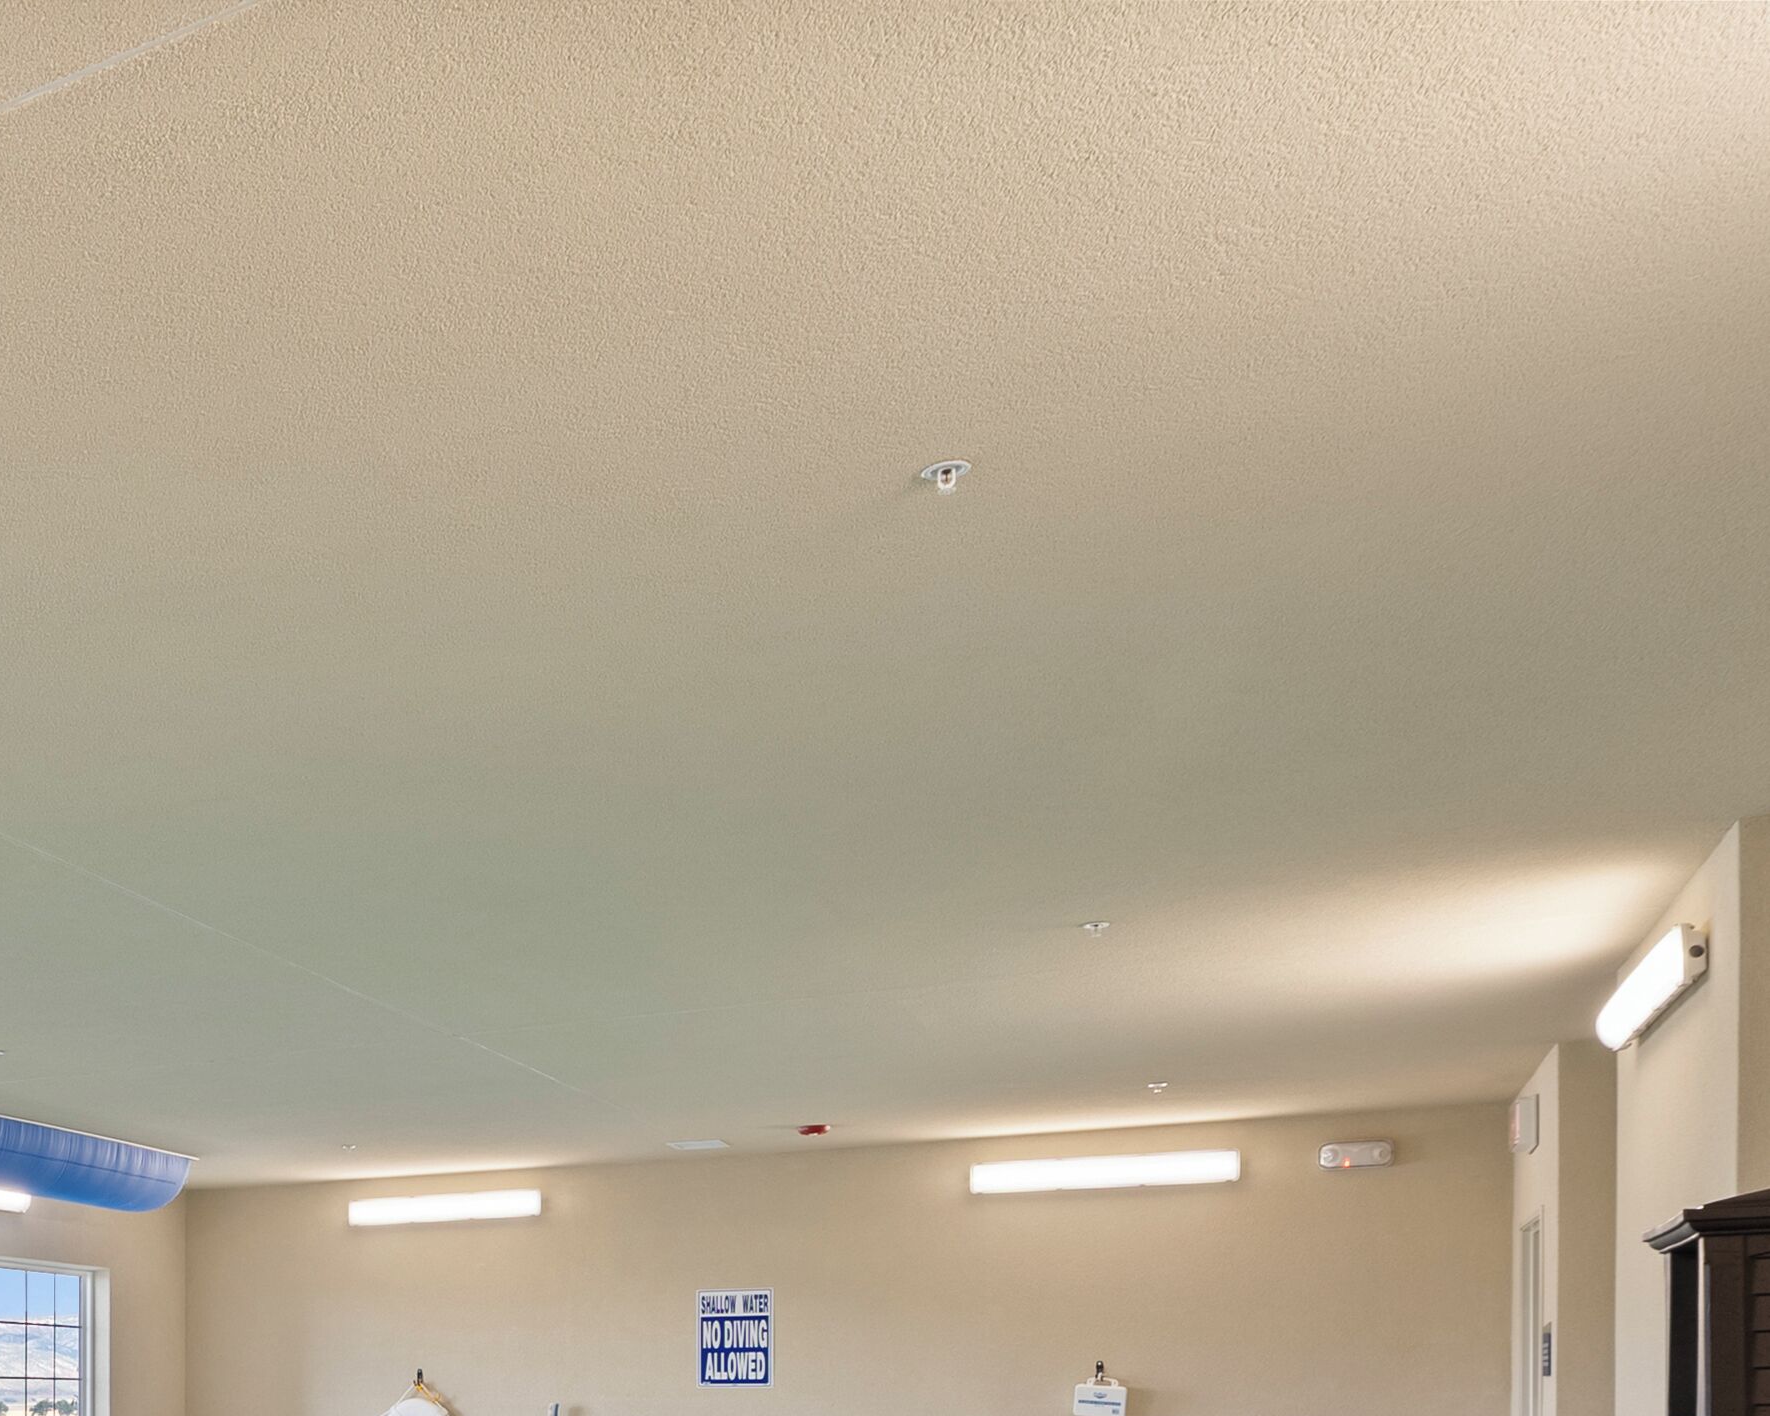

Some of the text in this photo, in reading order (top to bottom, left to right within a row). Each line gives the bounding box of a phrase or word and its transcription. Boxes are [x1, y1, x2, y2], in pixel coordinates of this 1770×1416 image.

[701, 1294, 769, 1314] SHALLOW WATER
[702, 1319, 768, 1349] NO DIVING
[704, 1351, 766, 1381] ALLOWED
